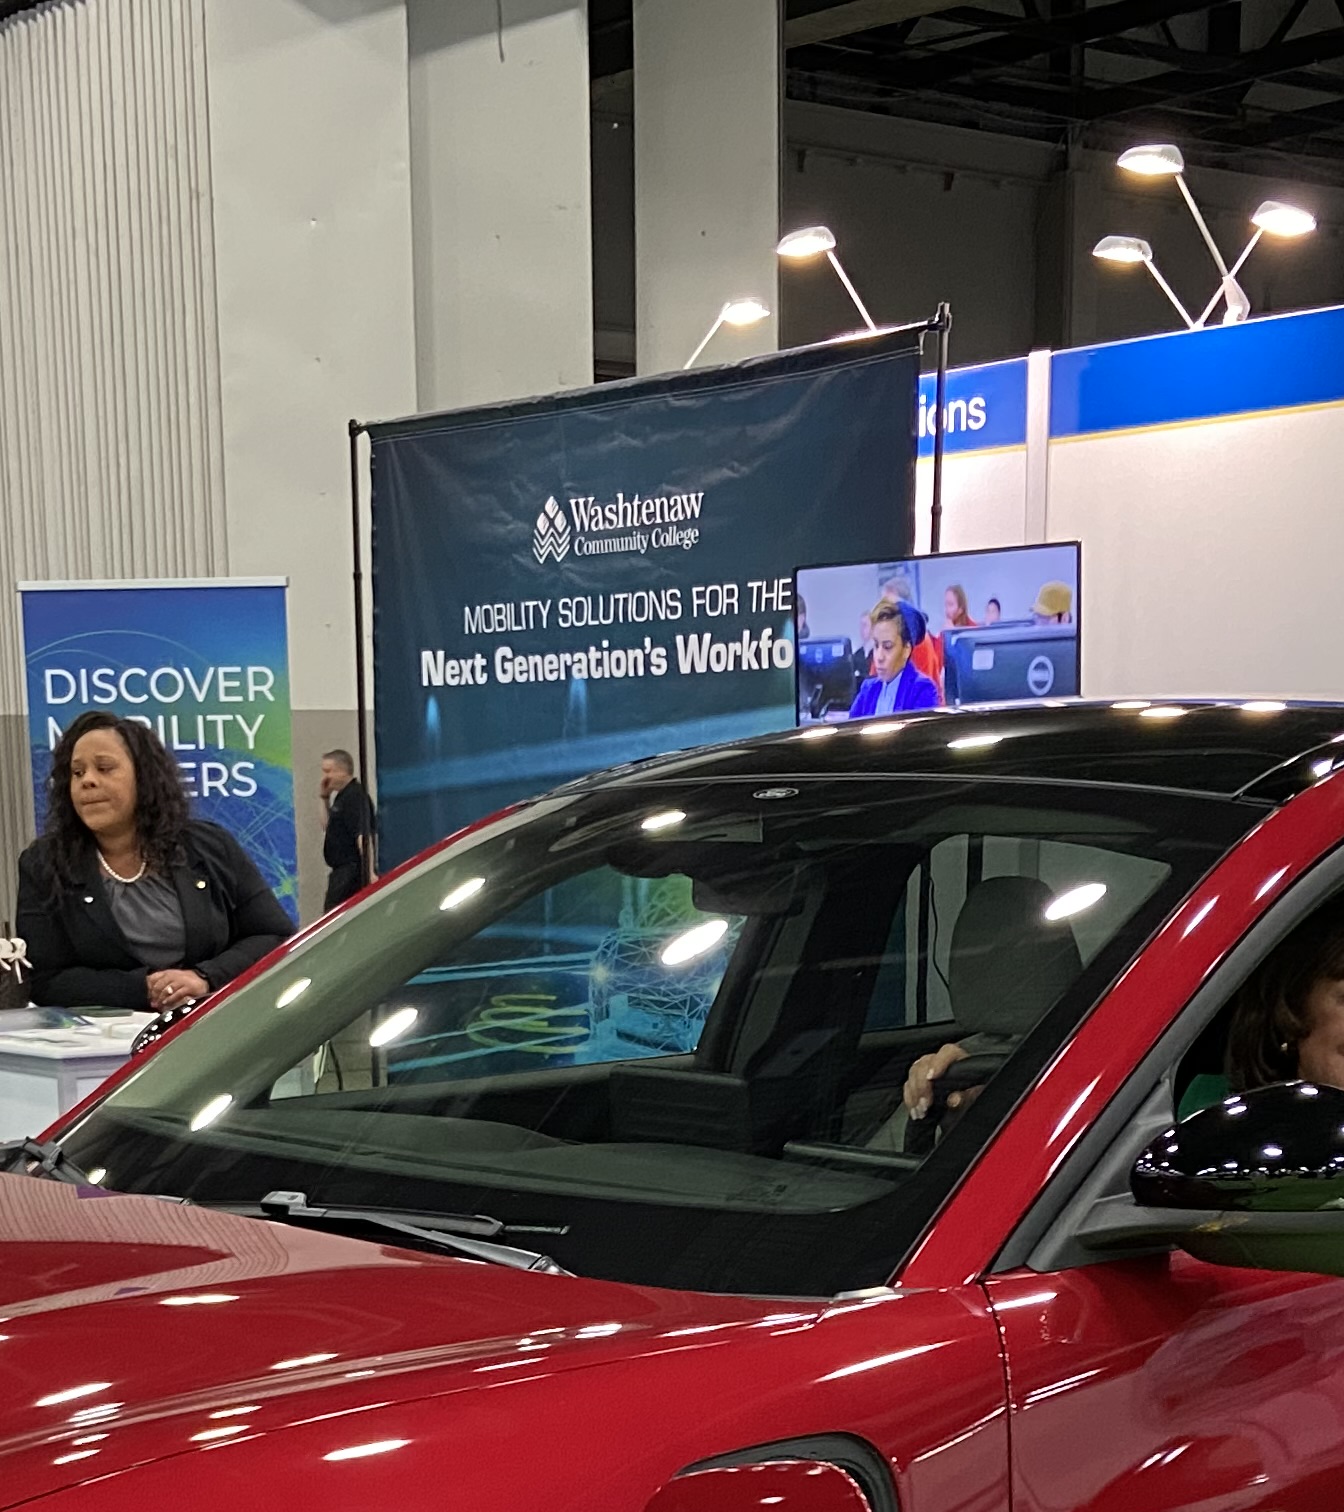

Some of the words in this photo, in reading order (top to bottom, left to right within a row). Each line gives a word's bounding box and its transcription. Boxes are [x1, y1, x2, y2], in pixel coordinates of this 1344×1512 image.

[569, 491, 704, 533] Washtenaw
[574, 531, 649, 557] Community
[651, 525, 700, 550] College
[464, 599, 551, 636] MOBILITY
[558, 588, 683, 629] SOLUTIONS
[692, 584, 739, 618] FOR
[747, 577, 793, 612] THE
[421, 649, 488, 687] Next
[494, 637, 668, 683] Generation's
[44, 666, 275, 705] DISCOVER
